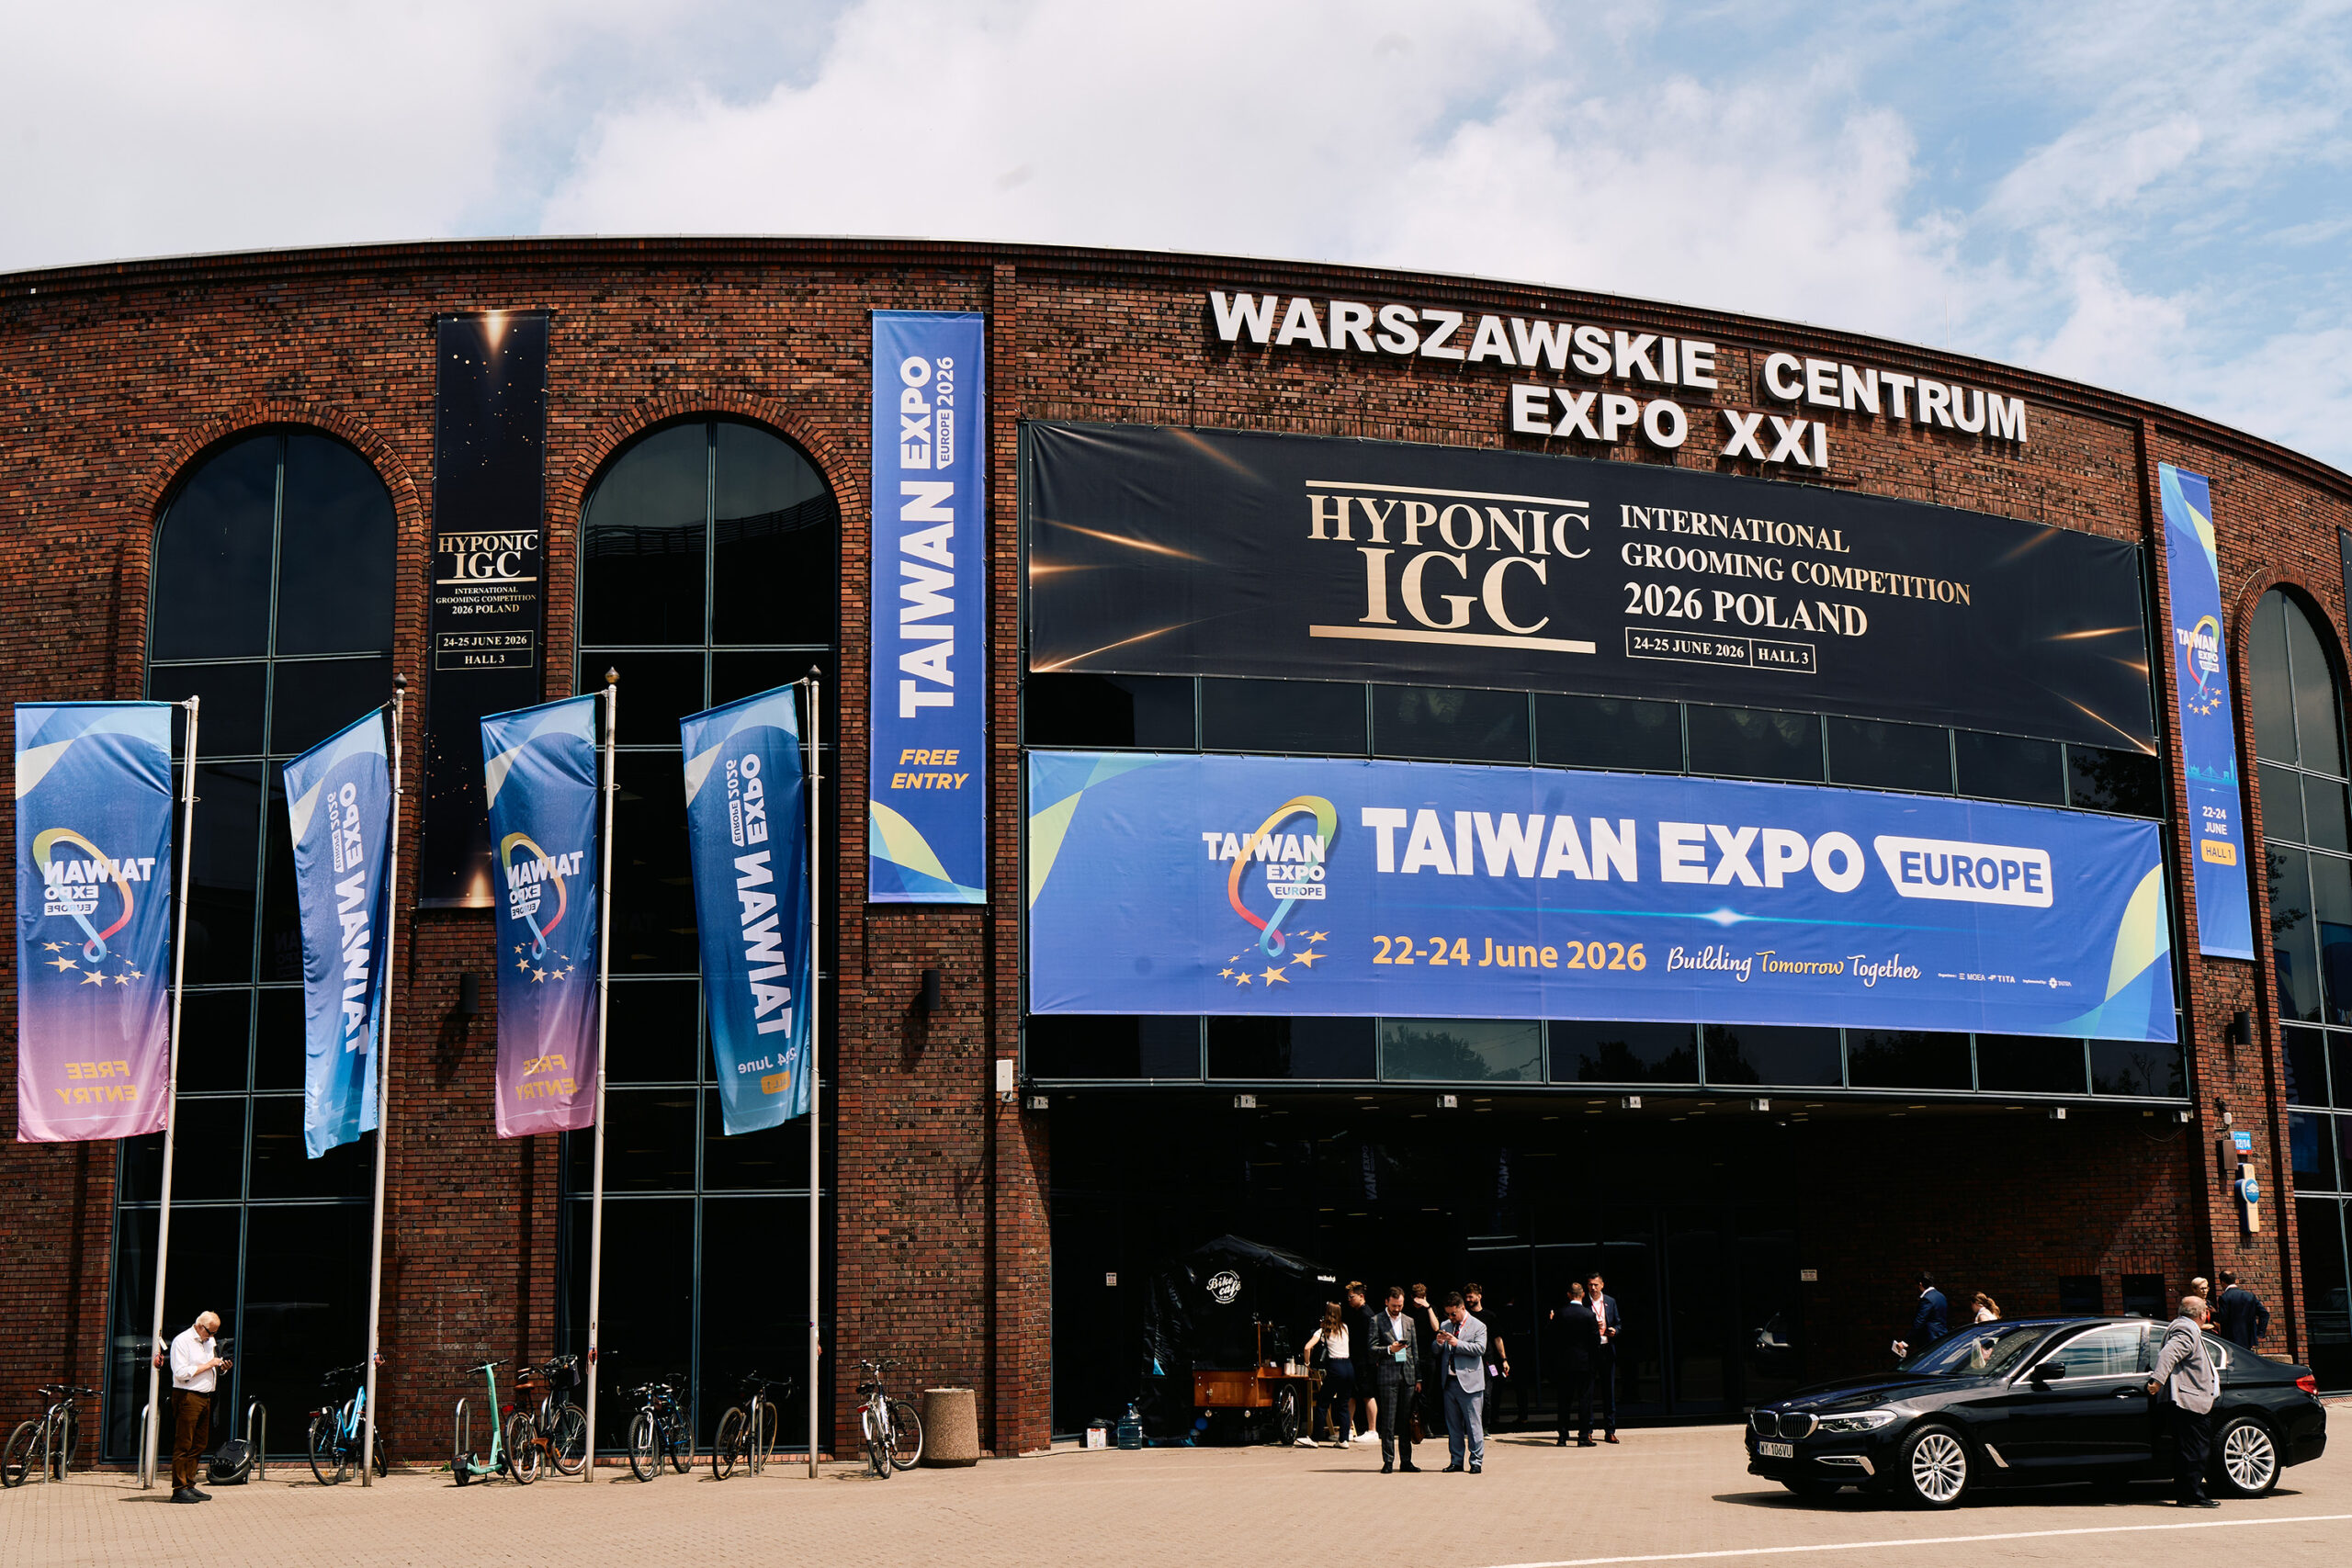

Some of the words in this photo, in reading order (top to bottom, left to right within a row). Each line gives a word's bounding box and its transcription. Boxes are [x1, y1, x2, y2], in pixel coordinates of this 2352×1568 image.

[1209, 290, 1718, 389] WARSZAWSKIE
[1762, 352, 2027, 443] CENTRUM
[937, 356, 954, 407] 2026
[899, 355, 932, 470] EXPO
[1511, 383, 1688, 448] EXPO
[1720, 409, 1828, 468] XXI
[940, 412, 951, 464] EUROPE
[1306, 494, 1591, 558] HYPONIC
[1620, 504, 1850, 553] INTERNATIONAL
[437, 534, 538, 553] HYPONIC
[453, 551, 521, 579] IGC
[1621, 542, 1784, 581] GROOMING
[1791, 560, 1971, 606] COMPETITION
[435, 596, 480, 604] GROOMING
[481, 594, 537, 603] COMPETITION
[455, 586, 518, 595] INTERNATIONAL
[899, 481, 955, 718] TAIWAN
[1356, 547, 1550, 634] IGC
[452, 605, 473, 615] 2026
[475, 604, 520, 614] POLAND
[1623, 581, 1703, 620] 2026
[1712, 590, 1869, 637] POLAND
[443, 637, 469, 647] 24-25
[471, 637, 502, 646] JUNE
[504, 636, 527, 645] 2026
[1633, 636, 1670, 652] 24-25
[1672, 639, 1713, 655] JUNE
[1715, 643, 1745, 659] 2026
[1758, 648, 1799, 663] HALL
[1801, 651, 1809, 665] 3
[2177, 628, 2218, 653] TAIWAN
[465, 655, 497, 664] HALL
[499, 654, 505, 664] 3
[899, 749, 959, 766] FREE
[890, 773, 969, 789] ENTRY
[2202, 806, 2227, 820] 22-24
[2205, 821, 2228, 836] JUNE
[1202, 832, 1325, 863] TAIWAN
[1362, 807, 1638, 882] TAIWAN
[1658, 821, 1865, 893] EXPO
[1900, 851, 2044, 894] EUROPE
[2205, 846, 2227, 859] HALL
[1266, 863, 1326, 882] EXPO
[1274, 886, 1323, 897] EUROPE
[1372, 935, 1471, 965] 22-24
[1477, 939, 1557, 968] June
[1566, 941, 1646, 972] 2026
[1667, 945, 1752, 983] Building
[1756, 951, 1845, 976] Tomorrow
[1848, 953, 1922, 988] Together
[1996, 975, 2016, 984] TITA
[1206, 1276, 1234, 1291] Bike
